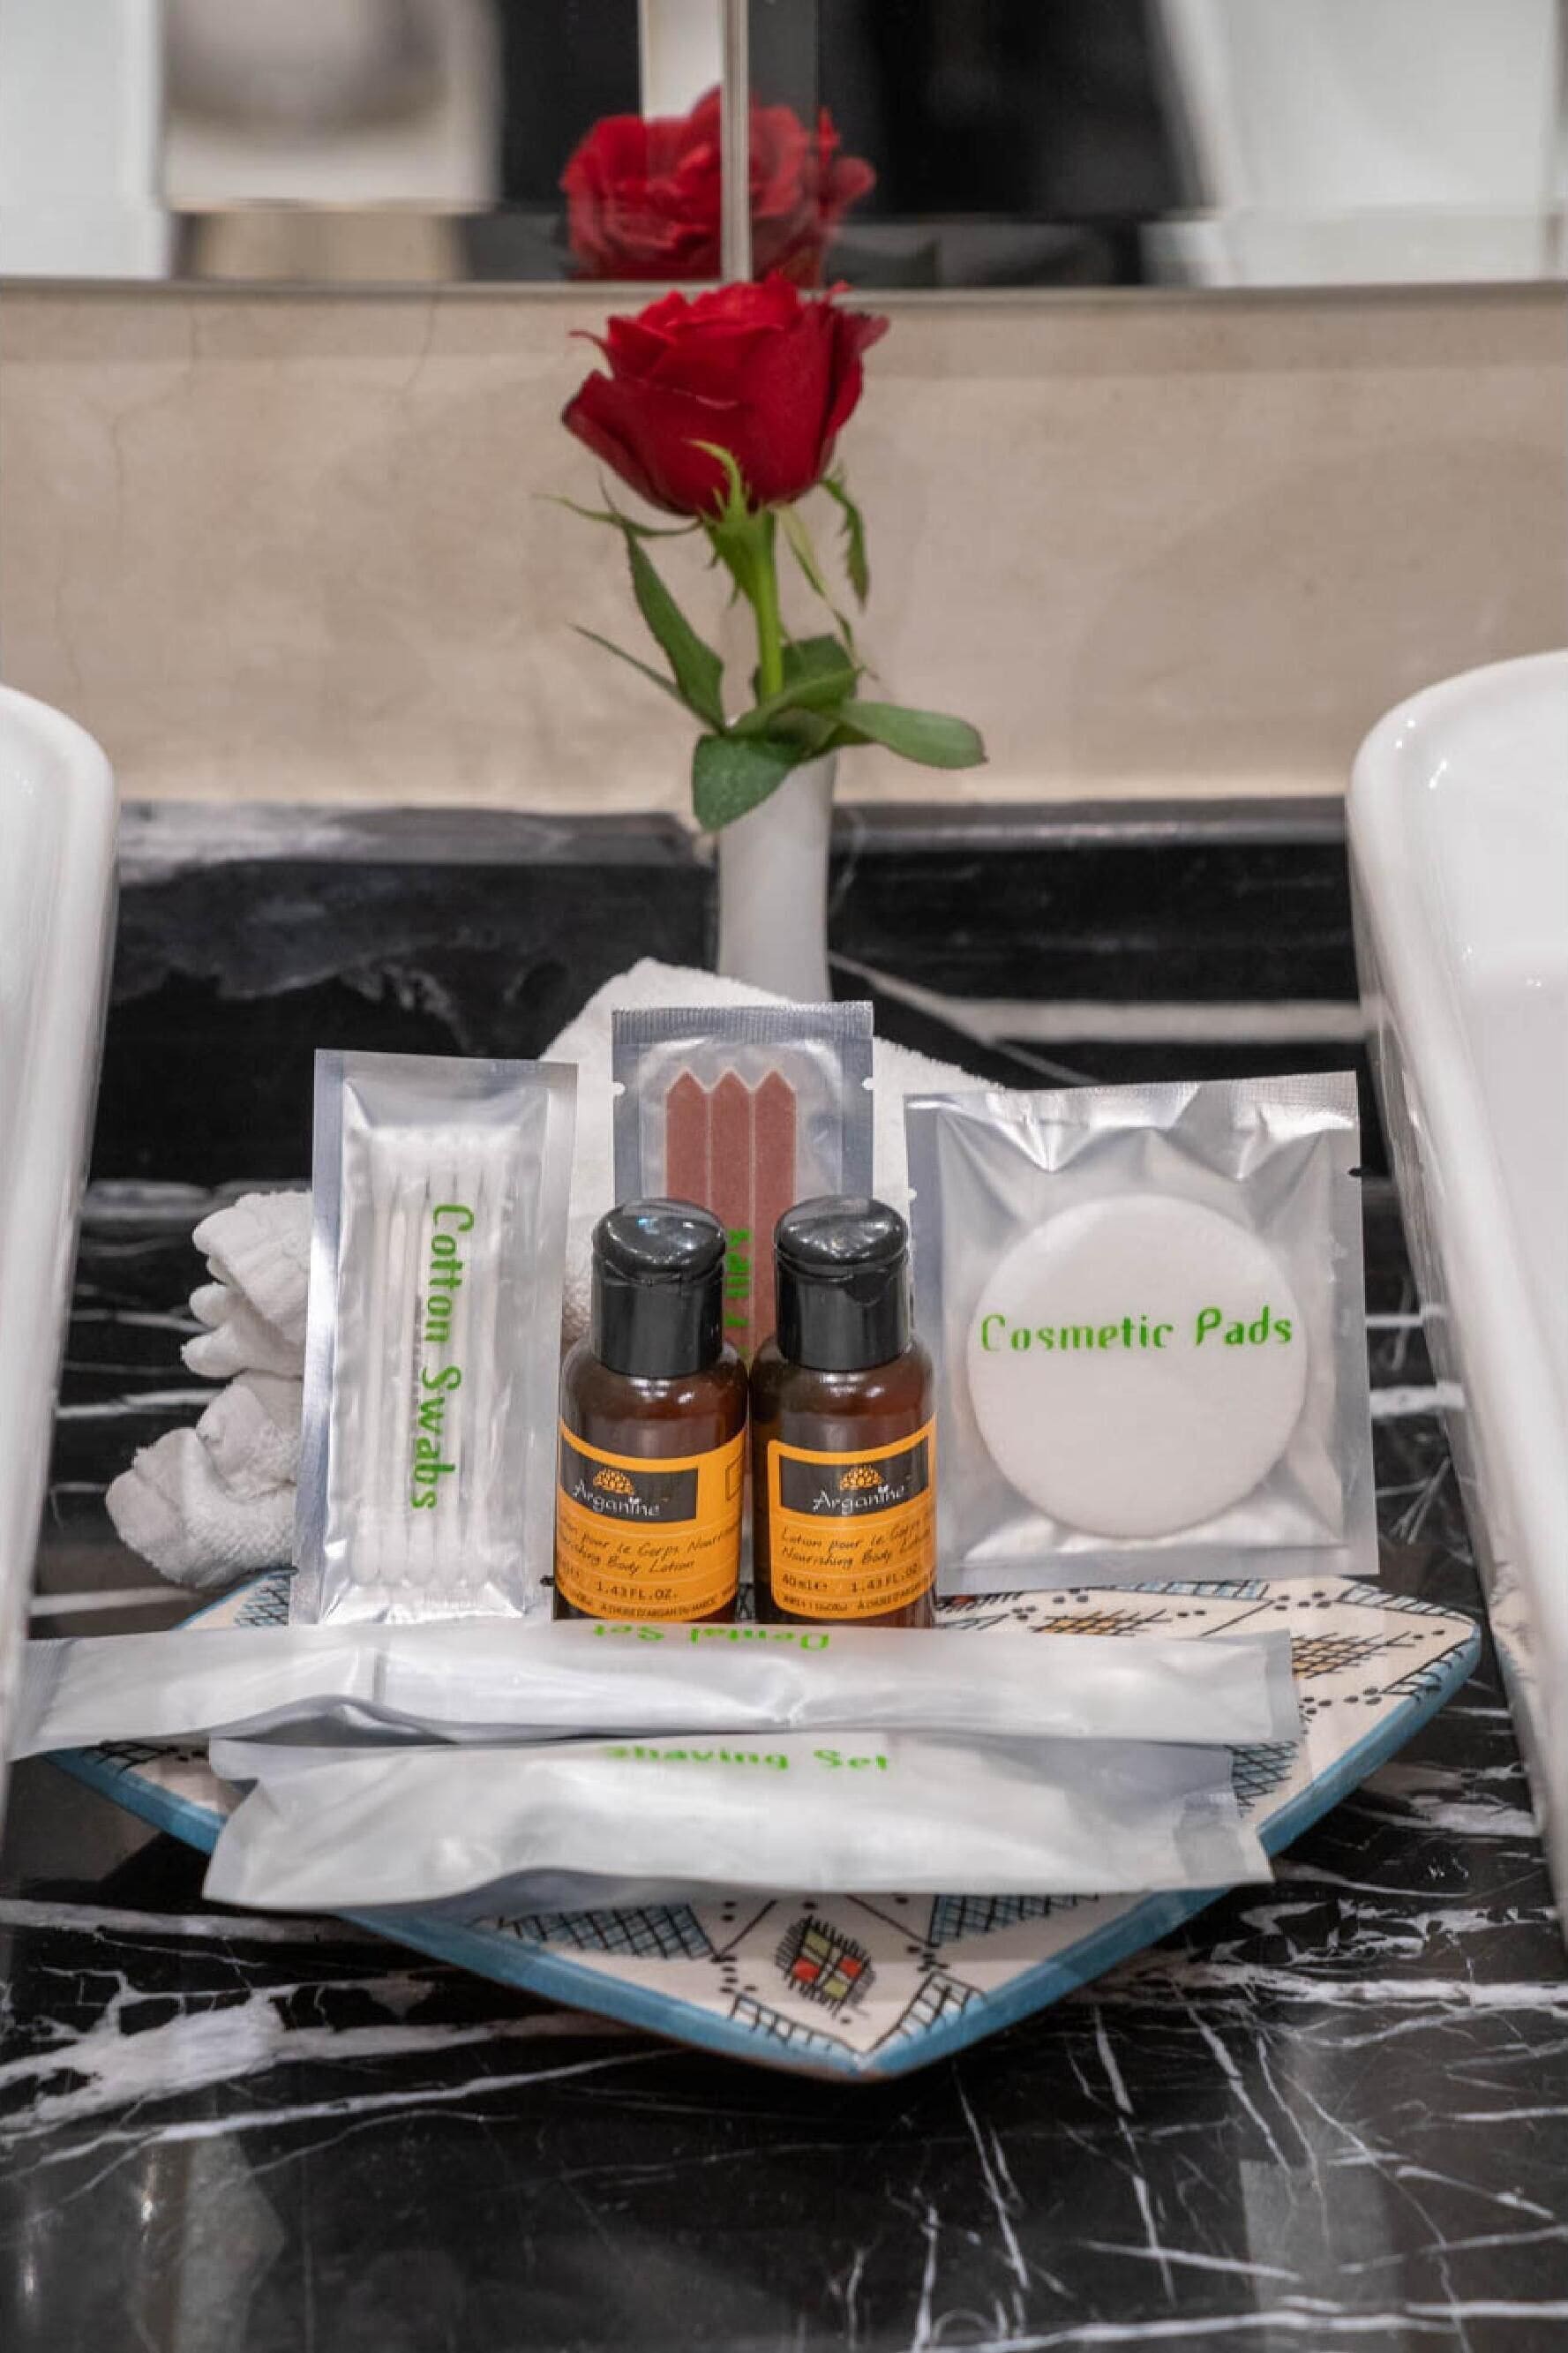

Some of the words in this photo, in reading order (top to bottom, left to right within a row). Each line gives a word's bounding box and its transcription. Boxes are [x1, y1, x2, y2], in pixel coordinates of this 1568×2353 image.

[427, 1203, 475, 1342] Cotton
[979, 1313, 1174, 1352] Cosmetic
[1194, 1304, 1294, 1348] Pads
[409, 1364, 462, 1510] Swabs
[571, 1478, 660, 1516] Arganine
[812, 1484, 905, 1516] Arganine
[781, 1545, 854, 1569] Nourishing
[861, 1547, 892, 1566] Body
[782, 1525, 822, 1548] Lotion
[828, 1538, 861, 1557] pour
[648, 1558, 695, 1575] Lotion
[814, 1748, 889, 1770] Set
